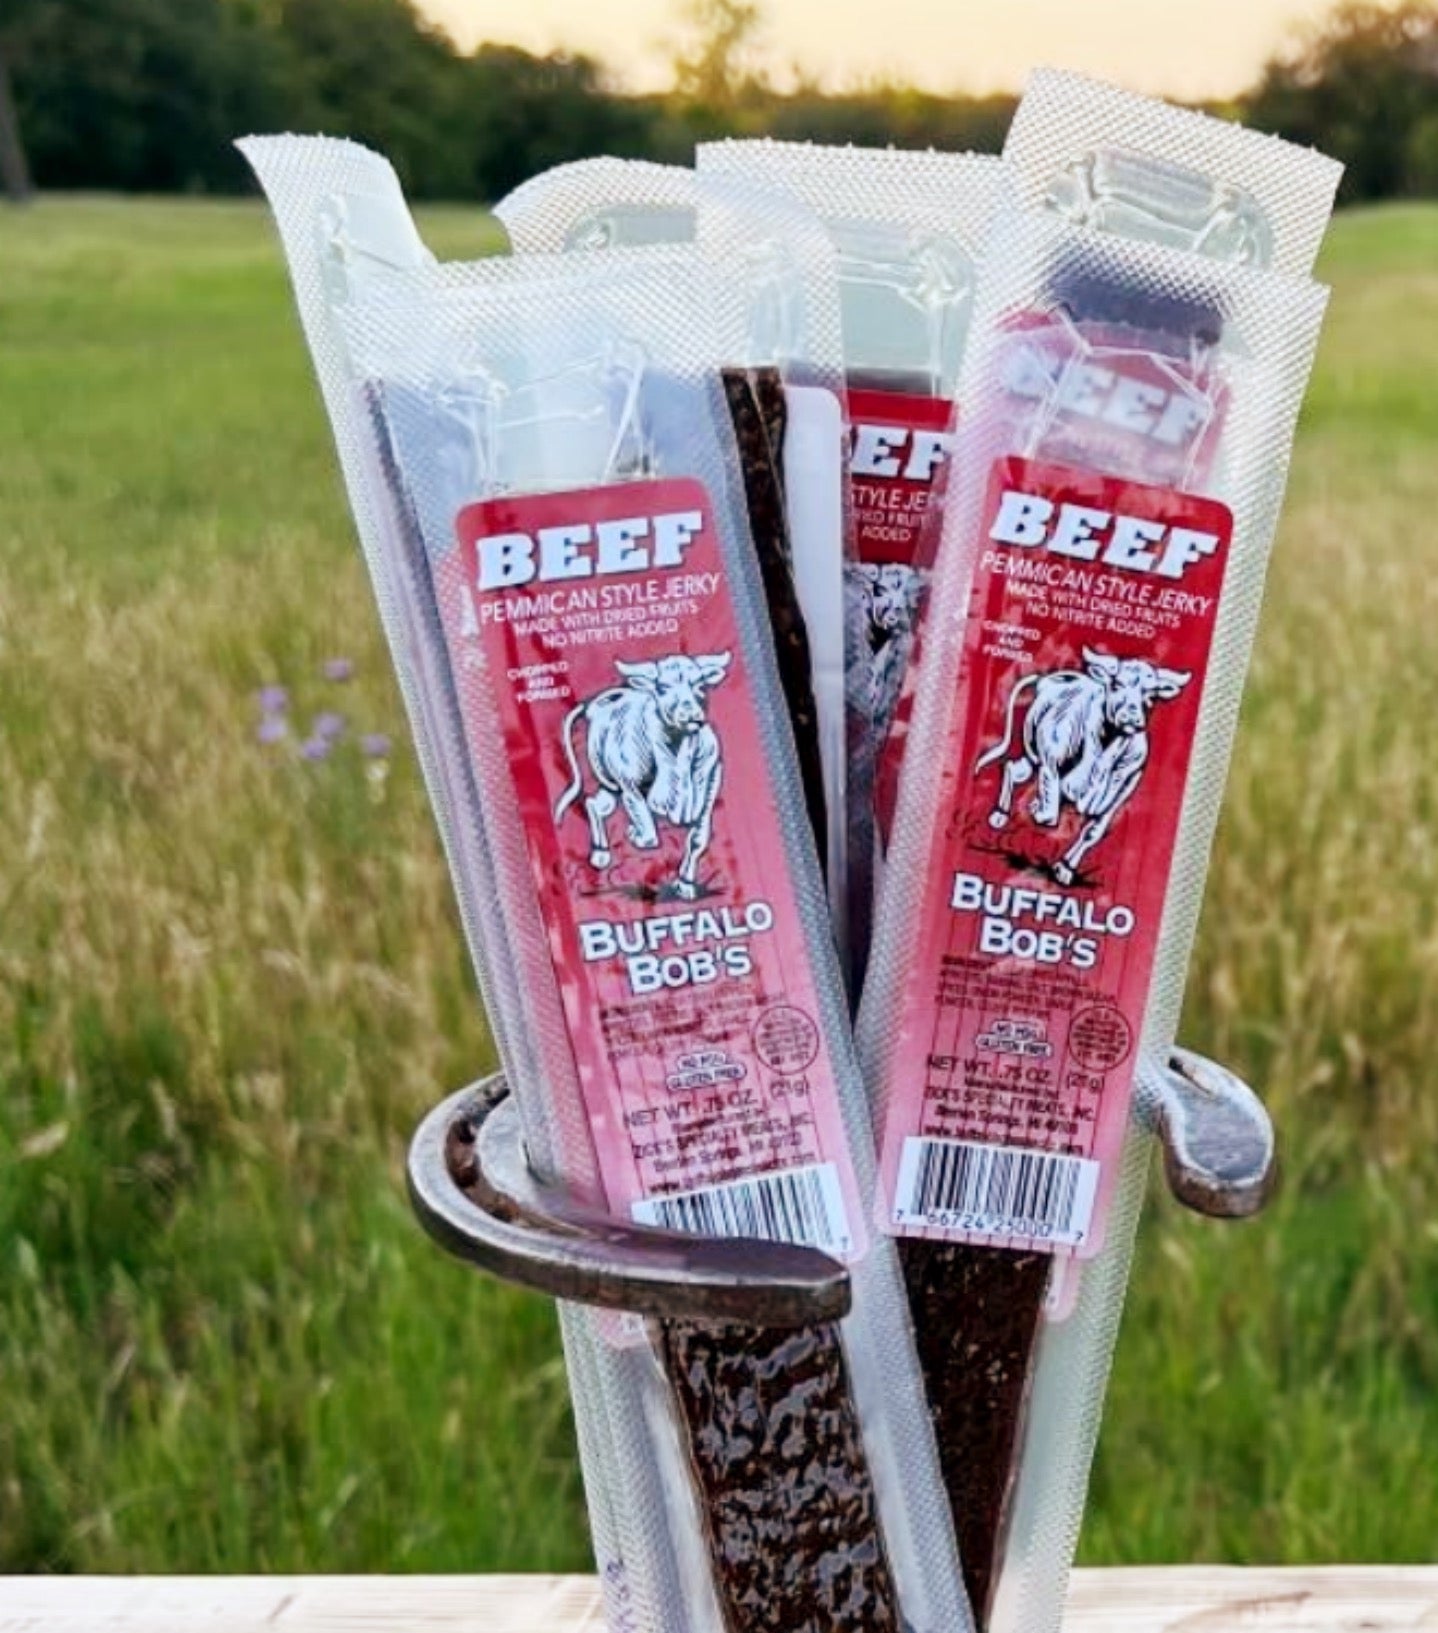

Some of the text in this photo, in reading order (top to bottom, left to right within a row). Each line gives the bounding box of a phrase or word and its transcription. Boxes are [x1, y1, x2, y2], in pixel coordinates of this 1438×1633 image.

[850, 424, 950, 481] EF
[476, 511, 702, 592] BEEF
[988, 490, 1220, 579] BEEF
[481, 572, 720, 625] PEMMICAN STYLE JERKY
[980, 551, 1213, 617] PEMMICAN STYLE JERKY
[1006, 579, 1048, 600] MADE
[1052, 591, 1086, 609] WITH
[1091, 597, 1132, 618] DRIED
[542, 631, 567, 649] NO
[1025, 600, 1049, 617] NO
[1107, 617, 1156, 639] ADDED
[951, 872, 1136, 935] BUFFALO
[579, 902, 774, 962] BUFFALO
[979, 917, 1098, 968] BOB'S
[626, 945, 751, 995] BOB'S
